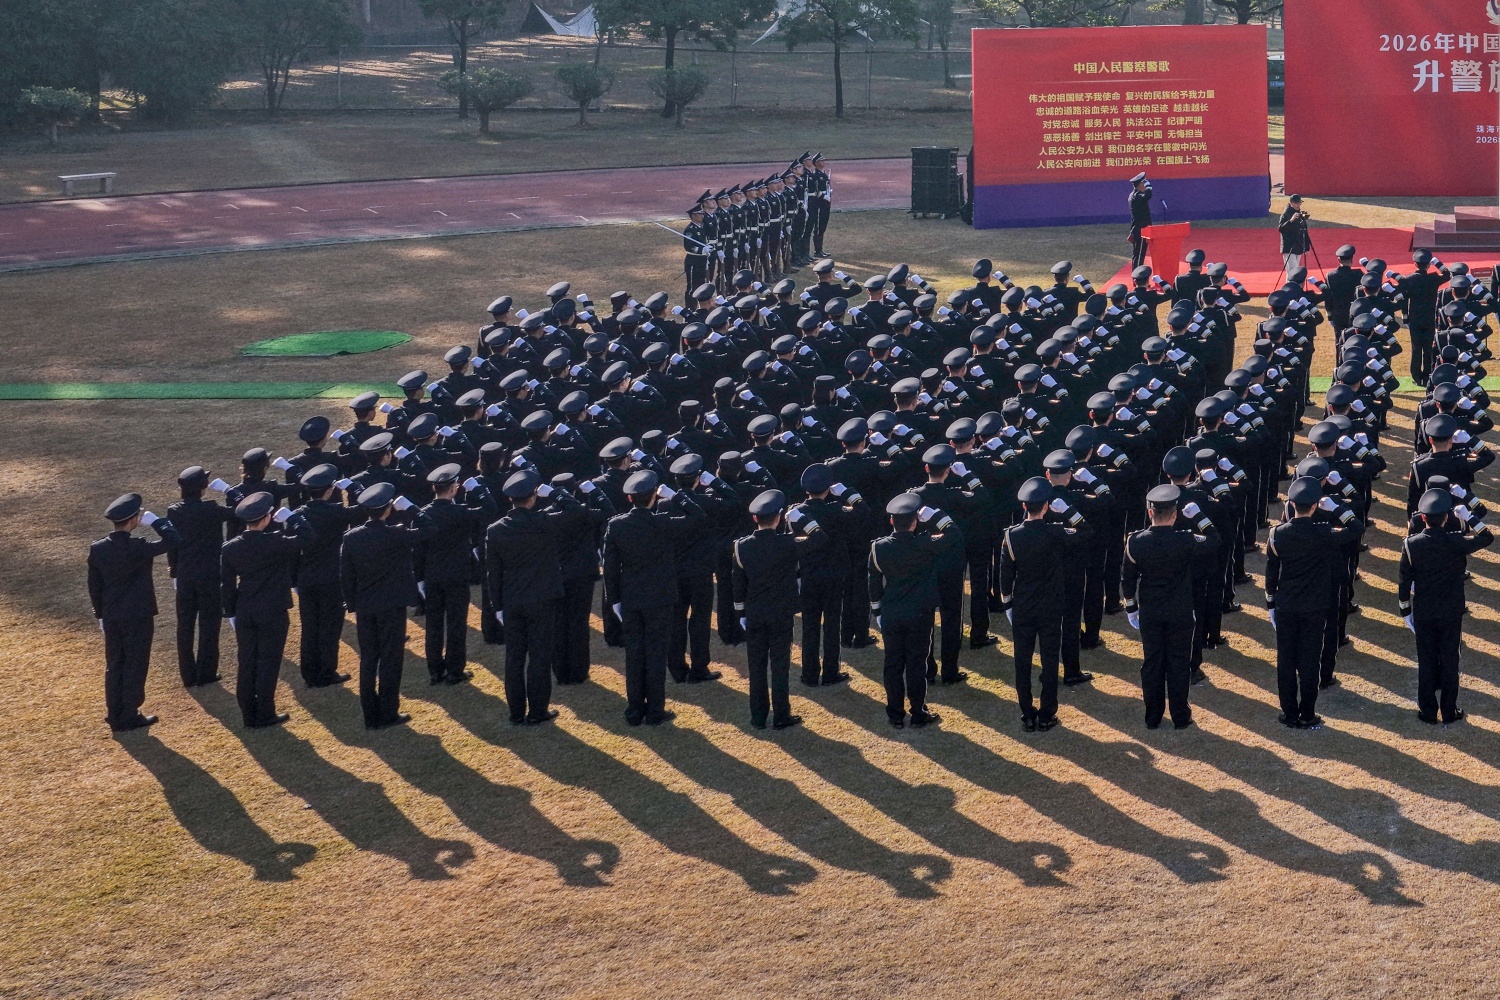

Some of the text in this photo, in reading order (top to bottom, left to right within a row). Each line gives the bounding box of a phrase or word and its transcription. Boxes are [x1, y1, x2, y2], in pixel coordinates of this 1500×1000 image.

[1073, 60, 1170, 74] 中国人民警察警歌
[1029, 90, 1216, 103] 伟大的祖国赋予我使命 复兴的民族给予我力量
[1036, 103, 1209, 116] 忠诚的道路浴血荣光 英雄的足迹 越走越长
[1042, 116, 1203, 129] 对党忠诚 服务人民 执法公正 纪律严明
[1043, 129, 1203, 143] 惩恶扬善 剑出锋芒 平安中国 无悔担当
[1039, 142, 1208, 156] 人民公安为人民 我们的名字在警徽中闪光
[1036, 154, 1210, 169] 人民公安向前进 我们的光荣 在国旗上飞扬
